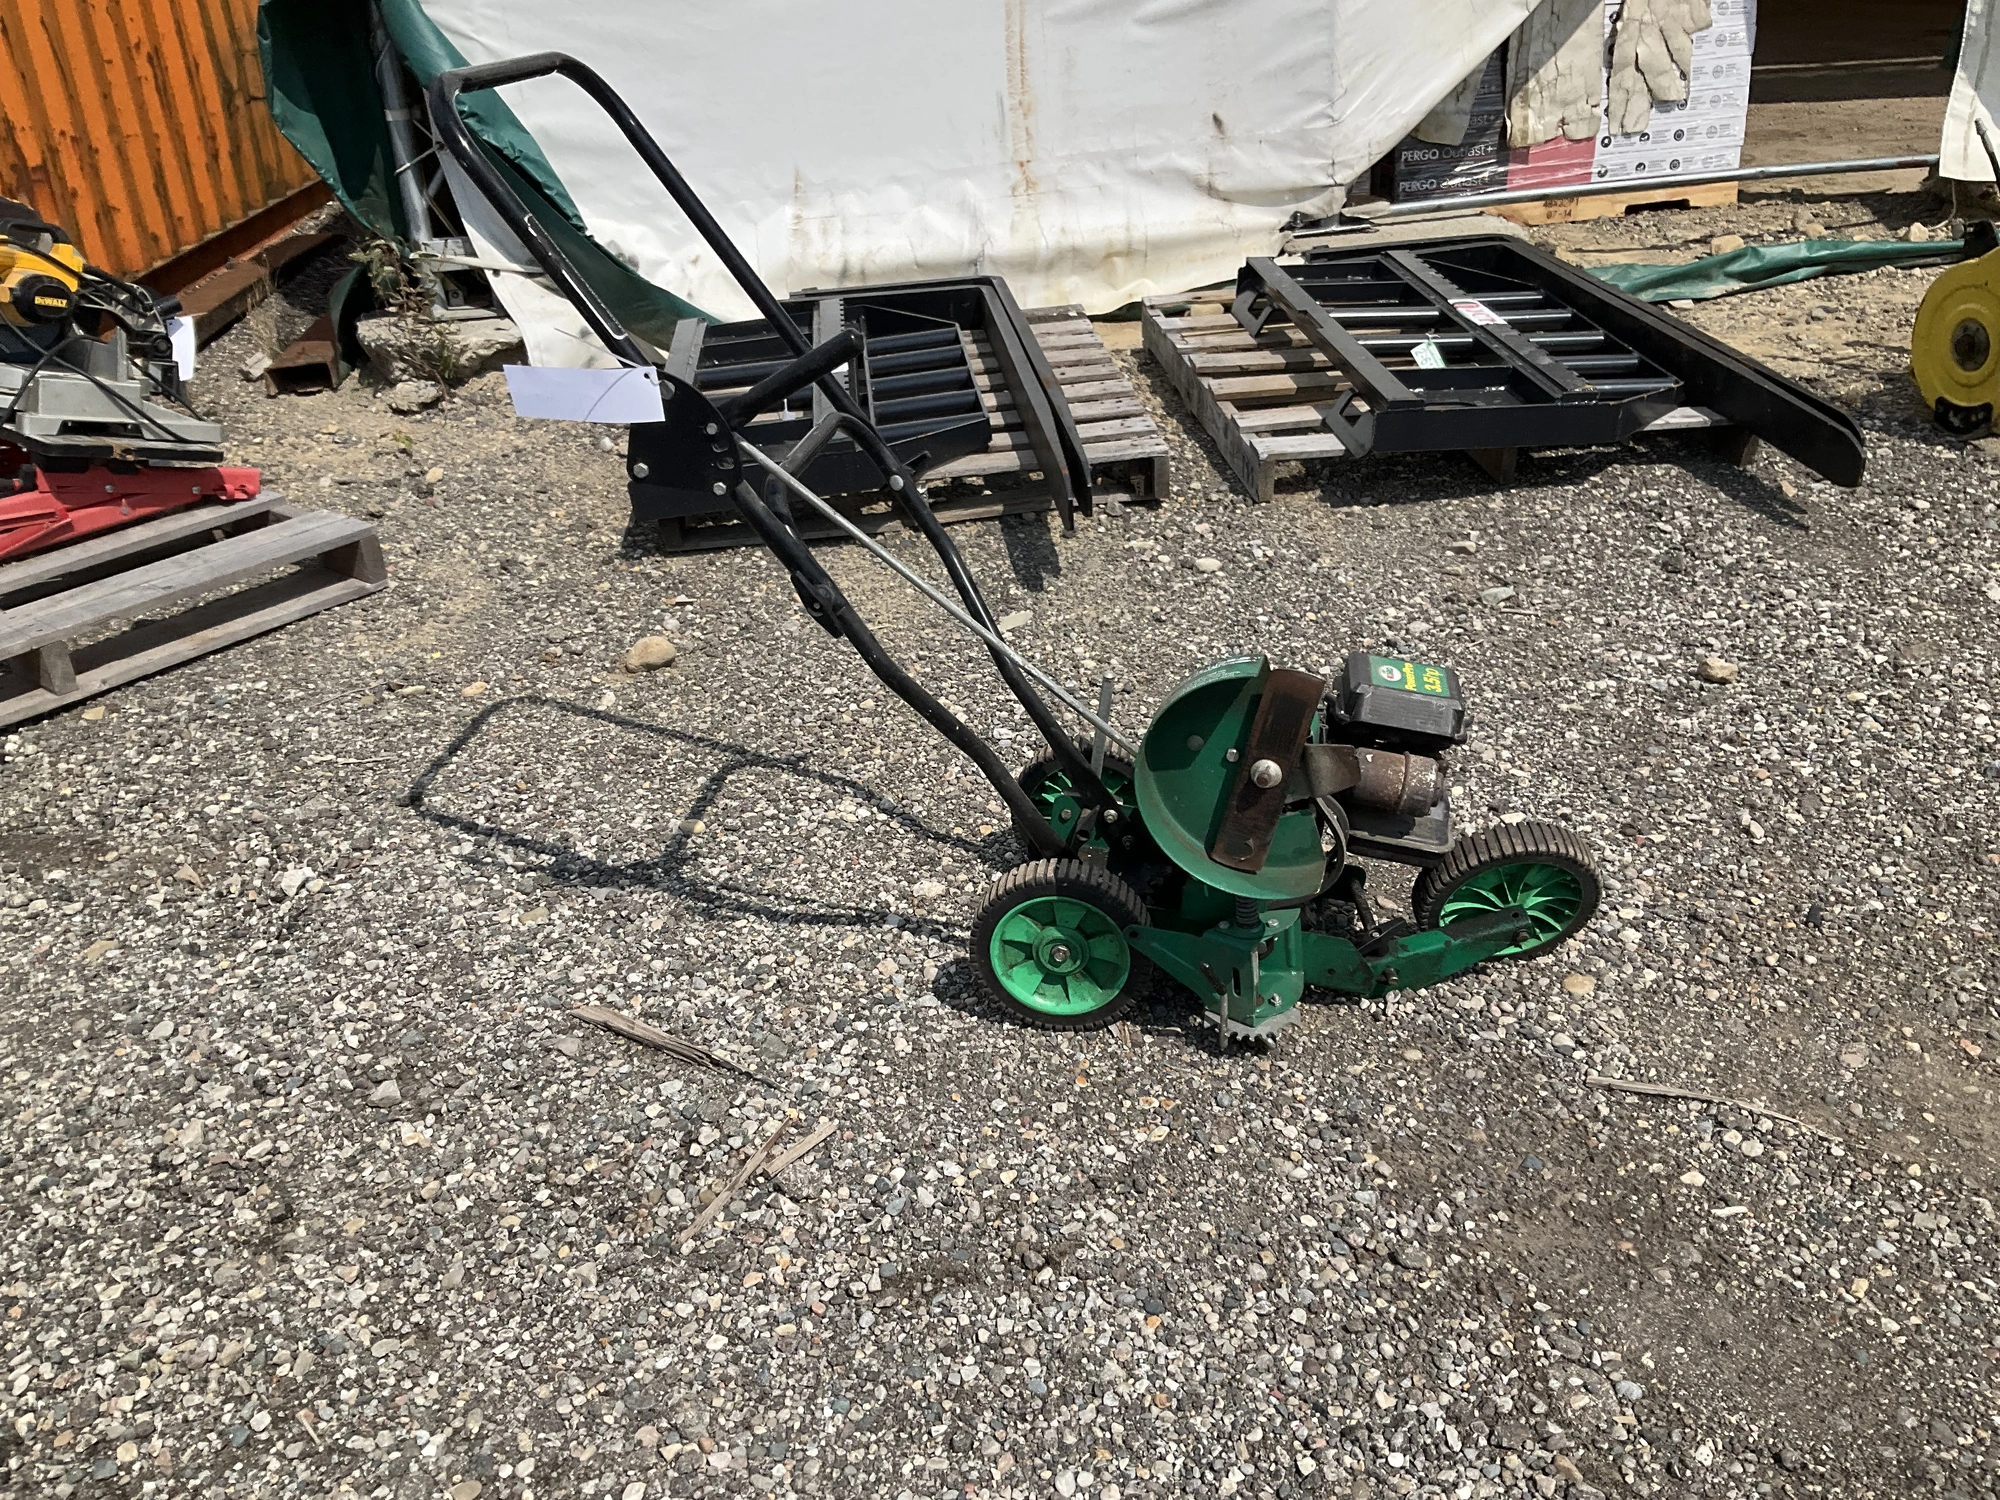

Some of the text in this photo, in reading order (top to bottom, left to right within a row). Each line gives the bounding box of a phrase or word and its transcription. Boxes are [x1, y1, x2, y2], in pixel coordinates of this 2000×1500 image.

[1401, 145, 1494, 162] PERGO Outlast+
[1399, 179, 1437, 192] PERGO
